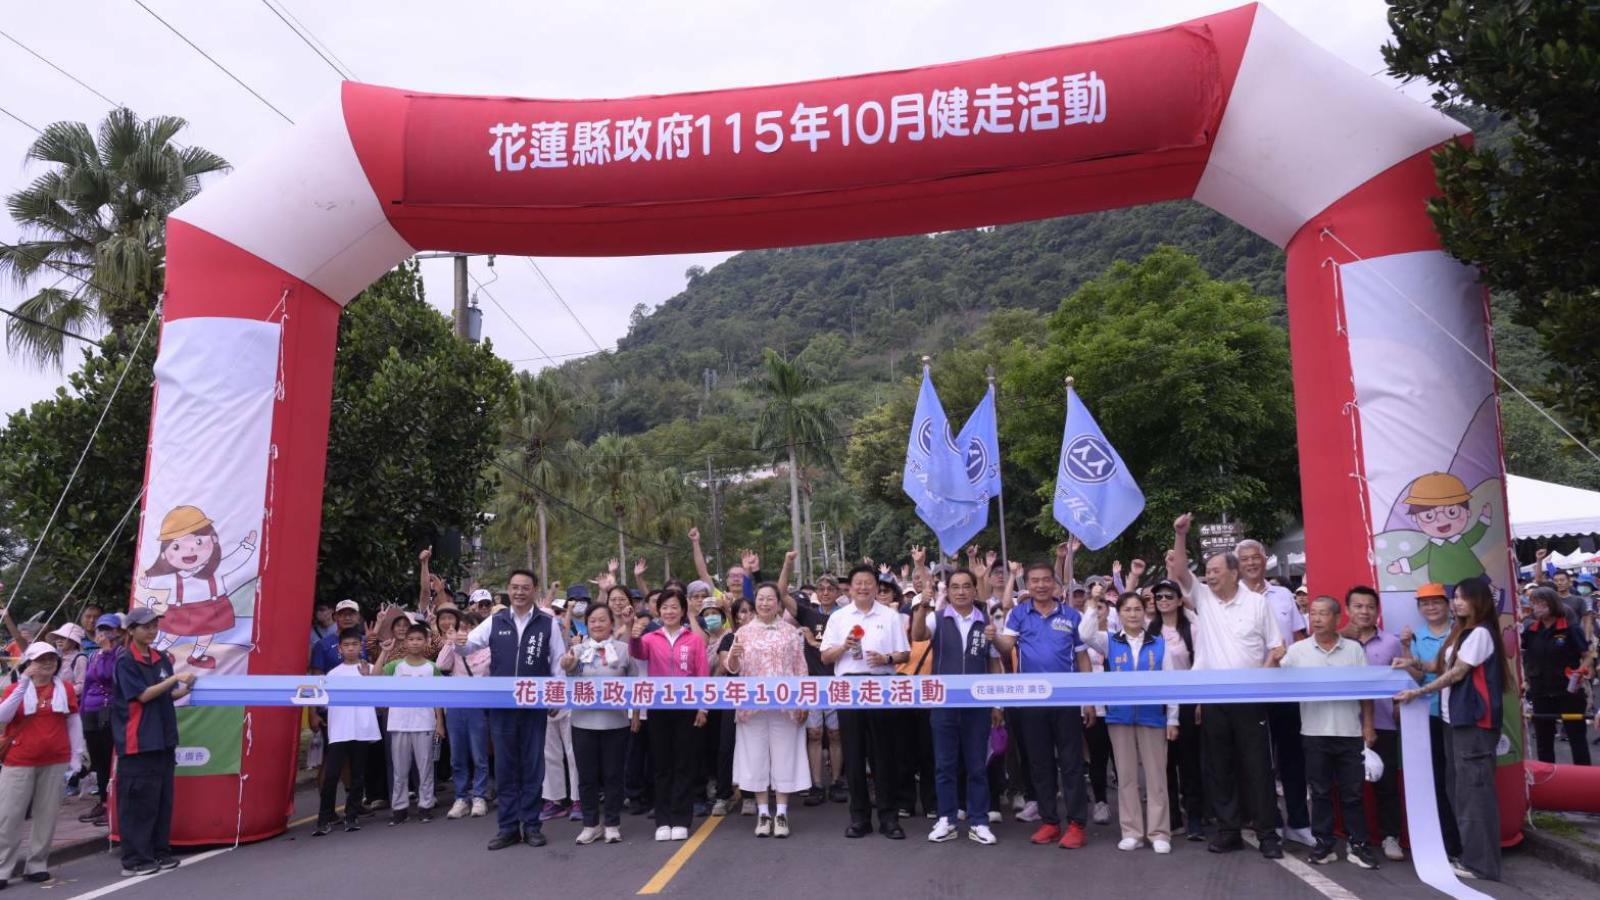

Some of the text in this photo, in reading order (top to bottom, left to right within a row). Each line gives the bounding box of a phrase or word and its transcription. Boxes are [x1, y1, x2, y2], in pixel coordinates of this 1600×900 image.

[487, 71, 1107, 172] 花蓮縣政府115年10月健走活動
[515, 679, 945, 705] 花蓮縣政府115年10月健走活動
